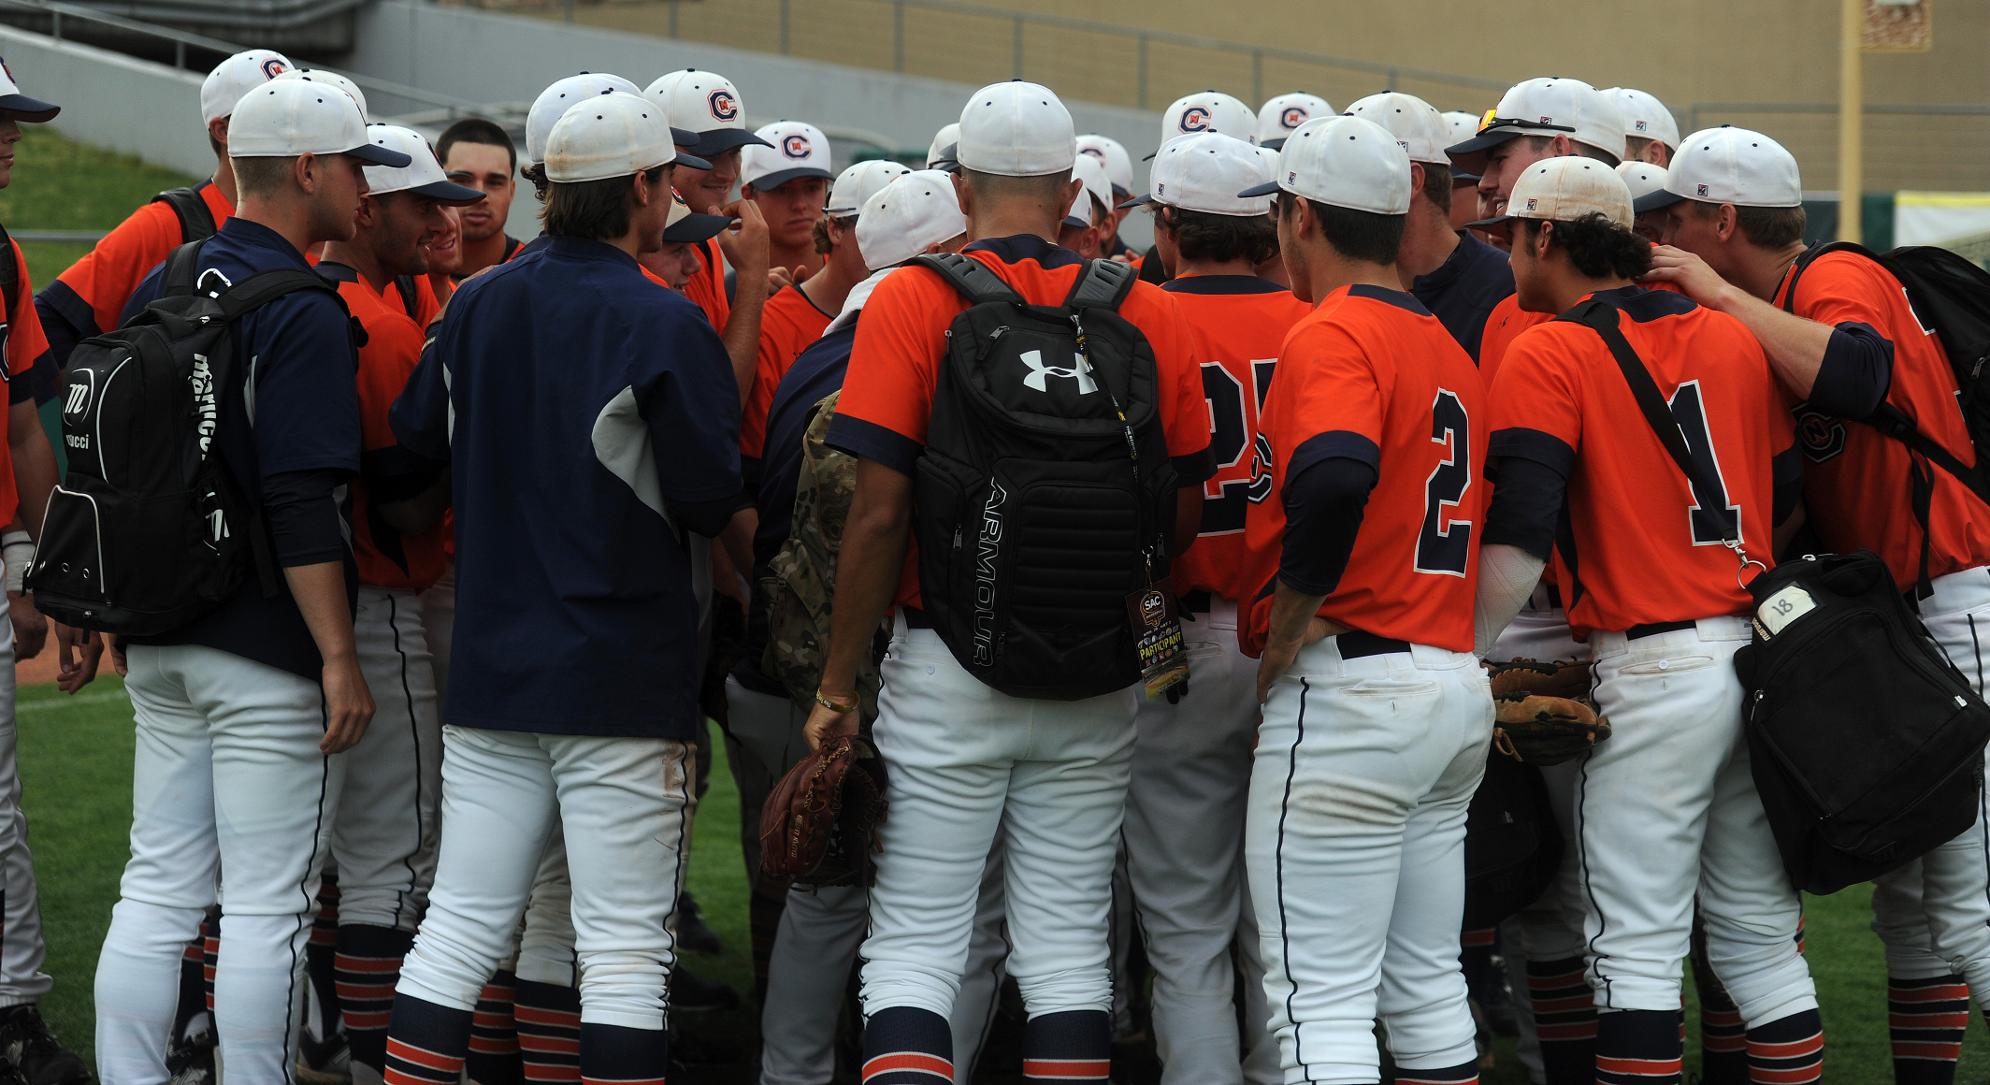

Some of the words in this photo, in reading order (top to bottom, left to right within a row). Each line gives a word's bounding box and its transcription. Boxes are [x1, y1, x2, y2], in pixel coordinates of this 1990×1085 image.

[1413, 386, 1472, 579] 2
[1667, 379, 1745, 547] 1
[973, 476, 1007, 667] ARMOUR
[1144, 595, 1161, 612] SAC
[1771, 598, 1793, 616] 18
[1139, 631, 1182, 660] PARTICIPANT
